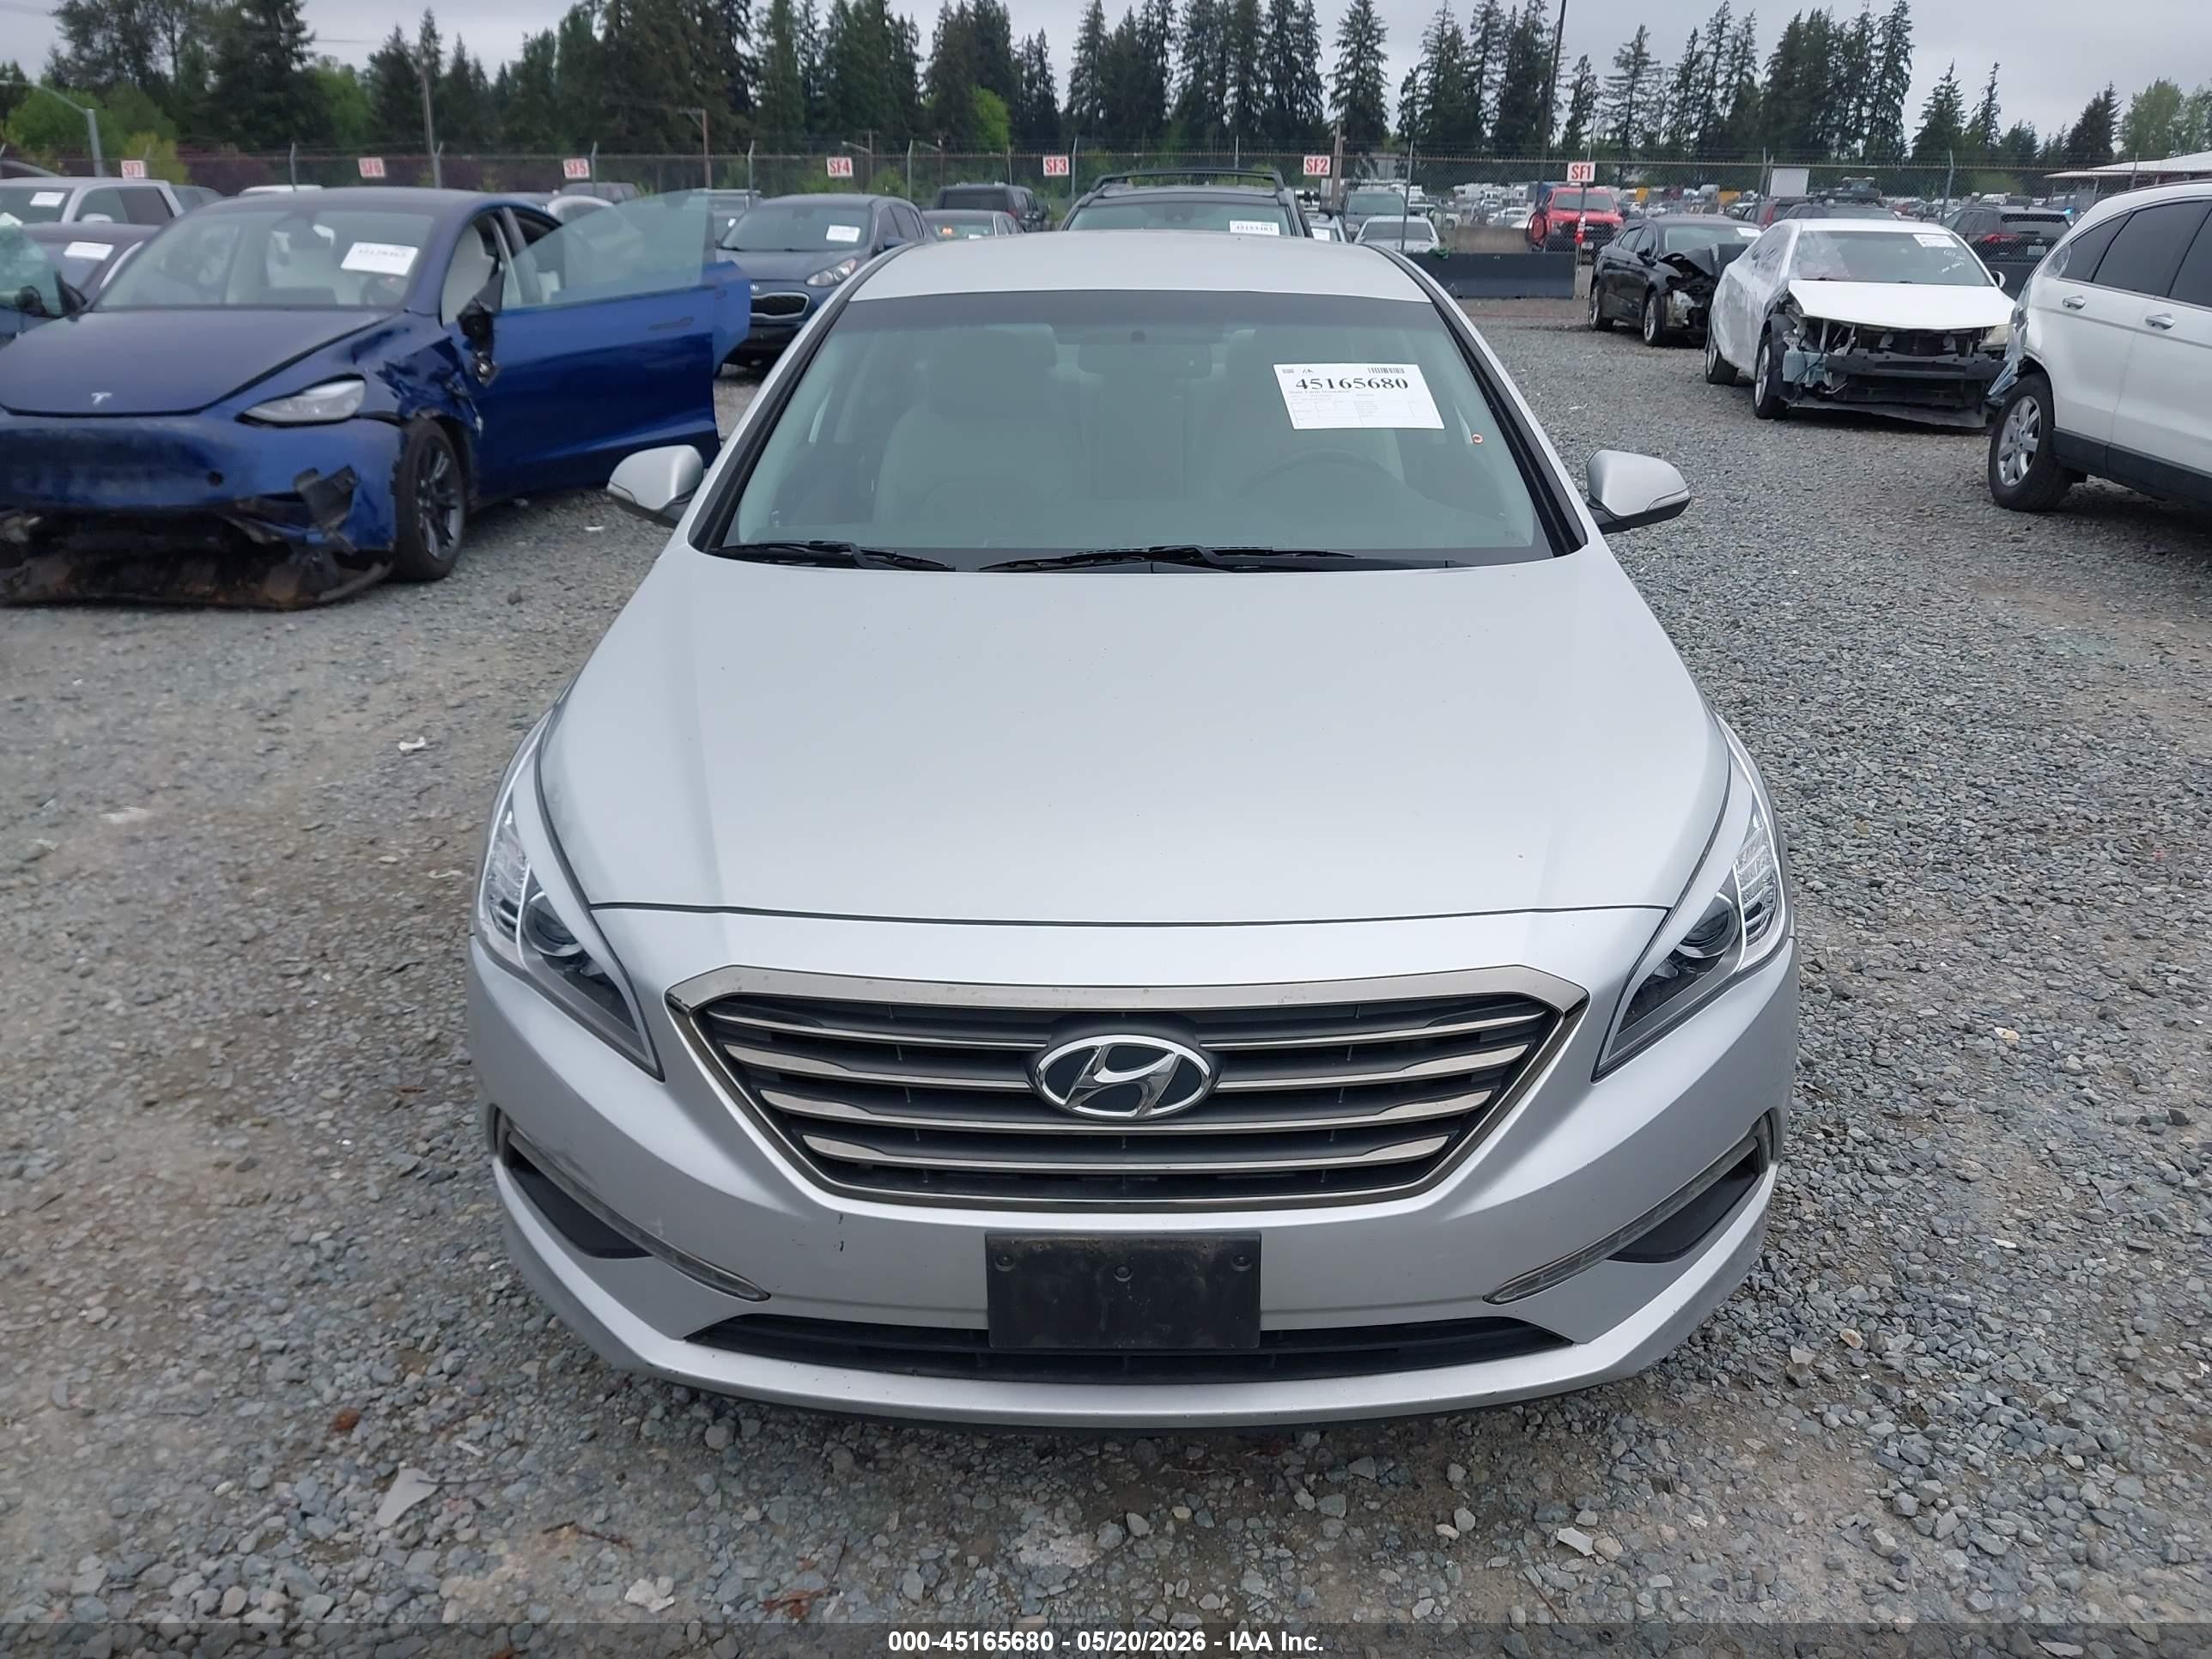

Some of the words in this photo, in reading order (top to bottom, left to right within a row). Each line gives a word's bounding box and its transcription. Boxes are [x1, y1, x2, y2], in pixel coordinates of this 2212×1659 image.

[830, 158, 849, 173] SF4
[1045, 158, 1066, 173] SF3
[1305, 157, 1328, 173] SF2
[1571, 164, 1591, 179] SF1
[1296, 377, 1408, 390] 45165680
